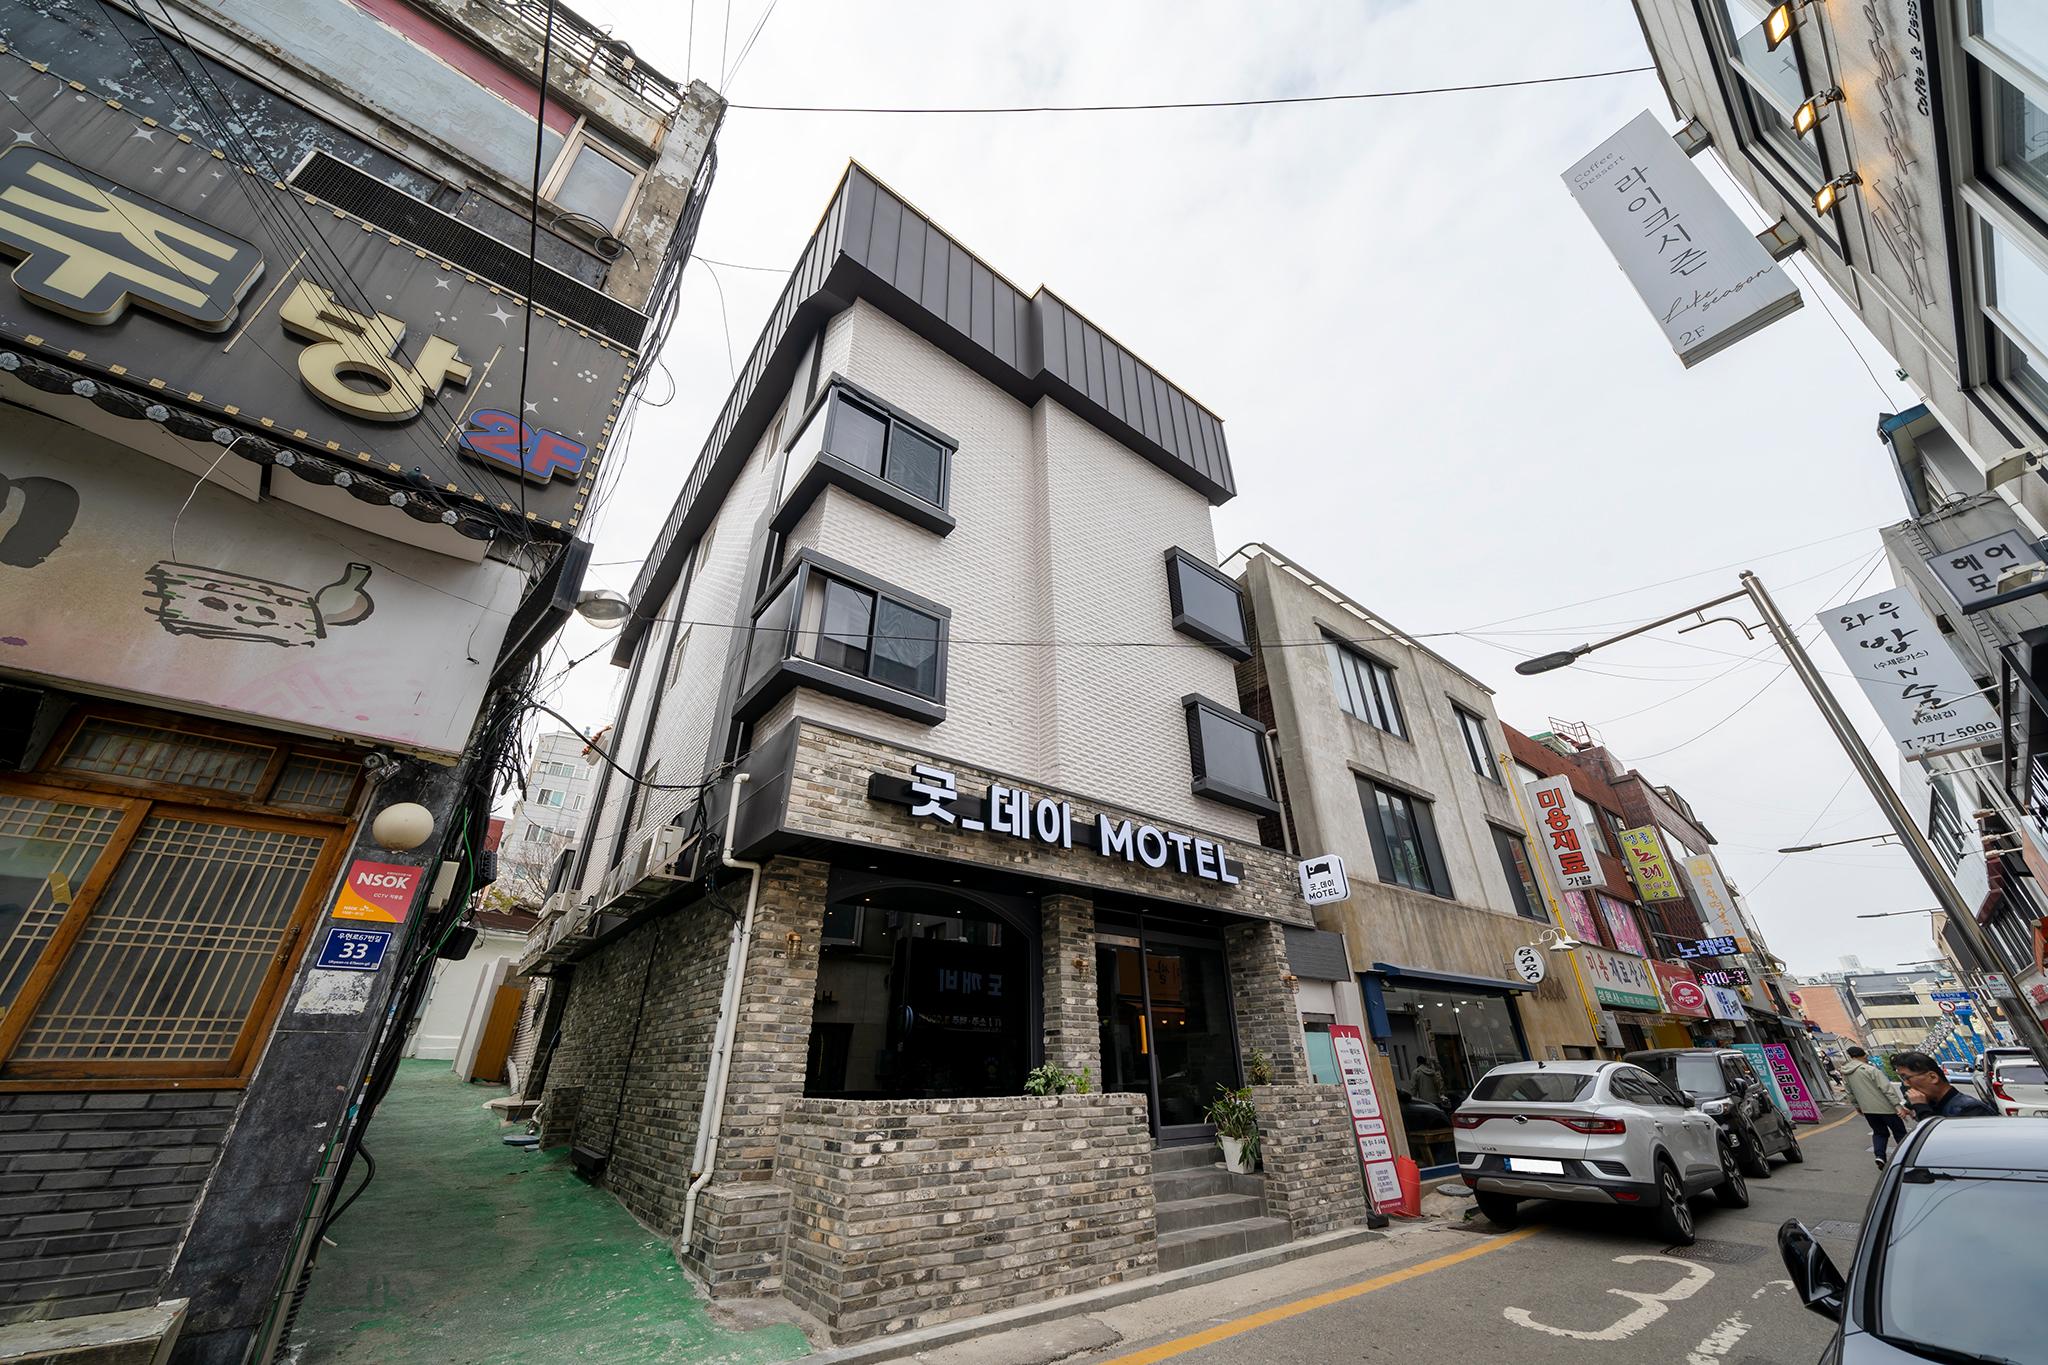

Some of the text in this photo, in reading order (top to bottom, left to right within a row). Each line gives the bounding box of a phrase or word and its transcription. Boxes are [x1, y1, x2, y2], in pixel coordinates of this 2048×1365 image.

[1910, 47, 1923, 61] &
[1862, 0, 1911, 176] seaso
[1910, 66, 1930, 117] Coffee
[1573, 151, 1614, 183] Coffee
[1578, 155, 1626, 191] Dessert
[1614, 166, 1708, 277] 라이크시즌
[1702, 265, 1774, 312] season
[1662, 289, 1718, 324] Like
[1679, 325, 1706, 347] 2F
[462, 408, 588, 480] 2F
[1950, 543, 2016, 571] 헤어
[1840, 601, 1900, 632] 와우
[910, 764, 1241, 884] 굿_데이 MOTEL
[1536, 787, 1591, 876] 미용재료
[1631, 848, 1664, 880] 노래
[356, 871, 411, 890] NSOK
[1308, 887, 1340, 901] MOTEL
[1566, 875, 1593, 887] 가발
[338, 942, 369, 960] 33
[1677, 936, 1737, 959] 노래방
[1771, 1060, 1801, 1101] 노래방
